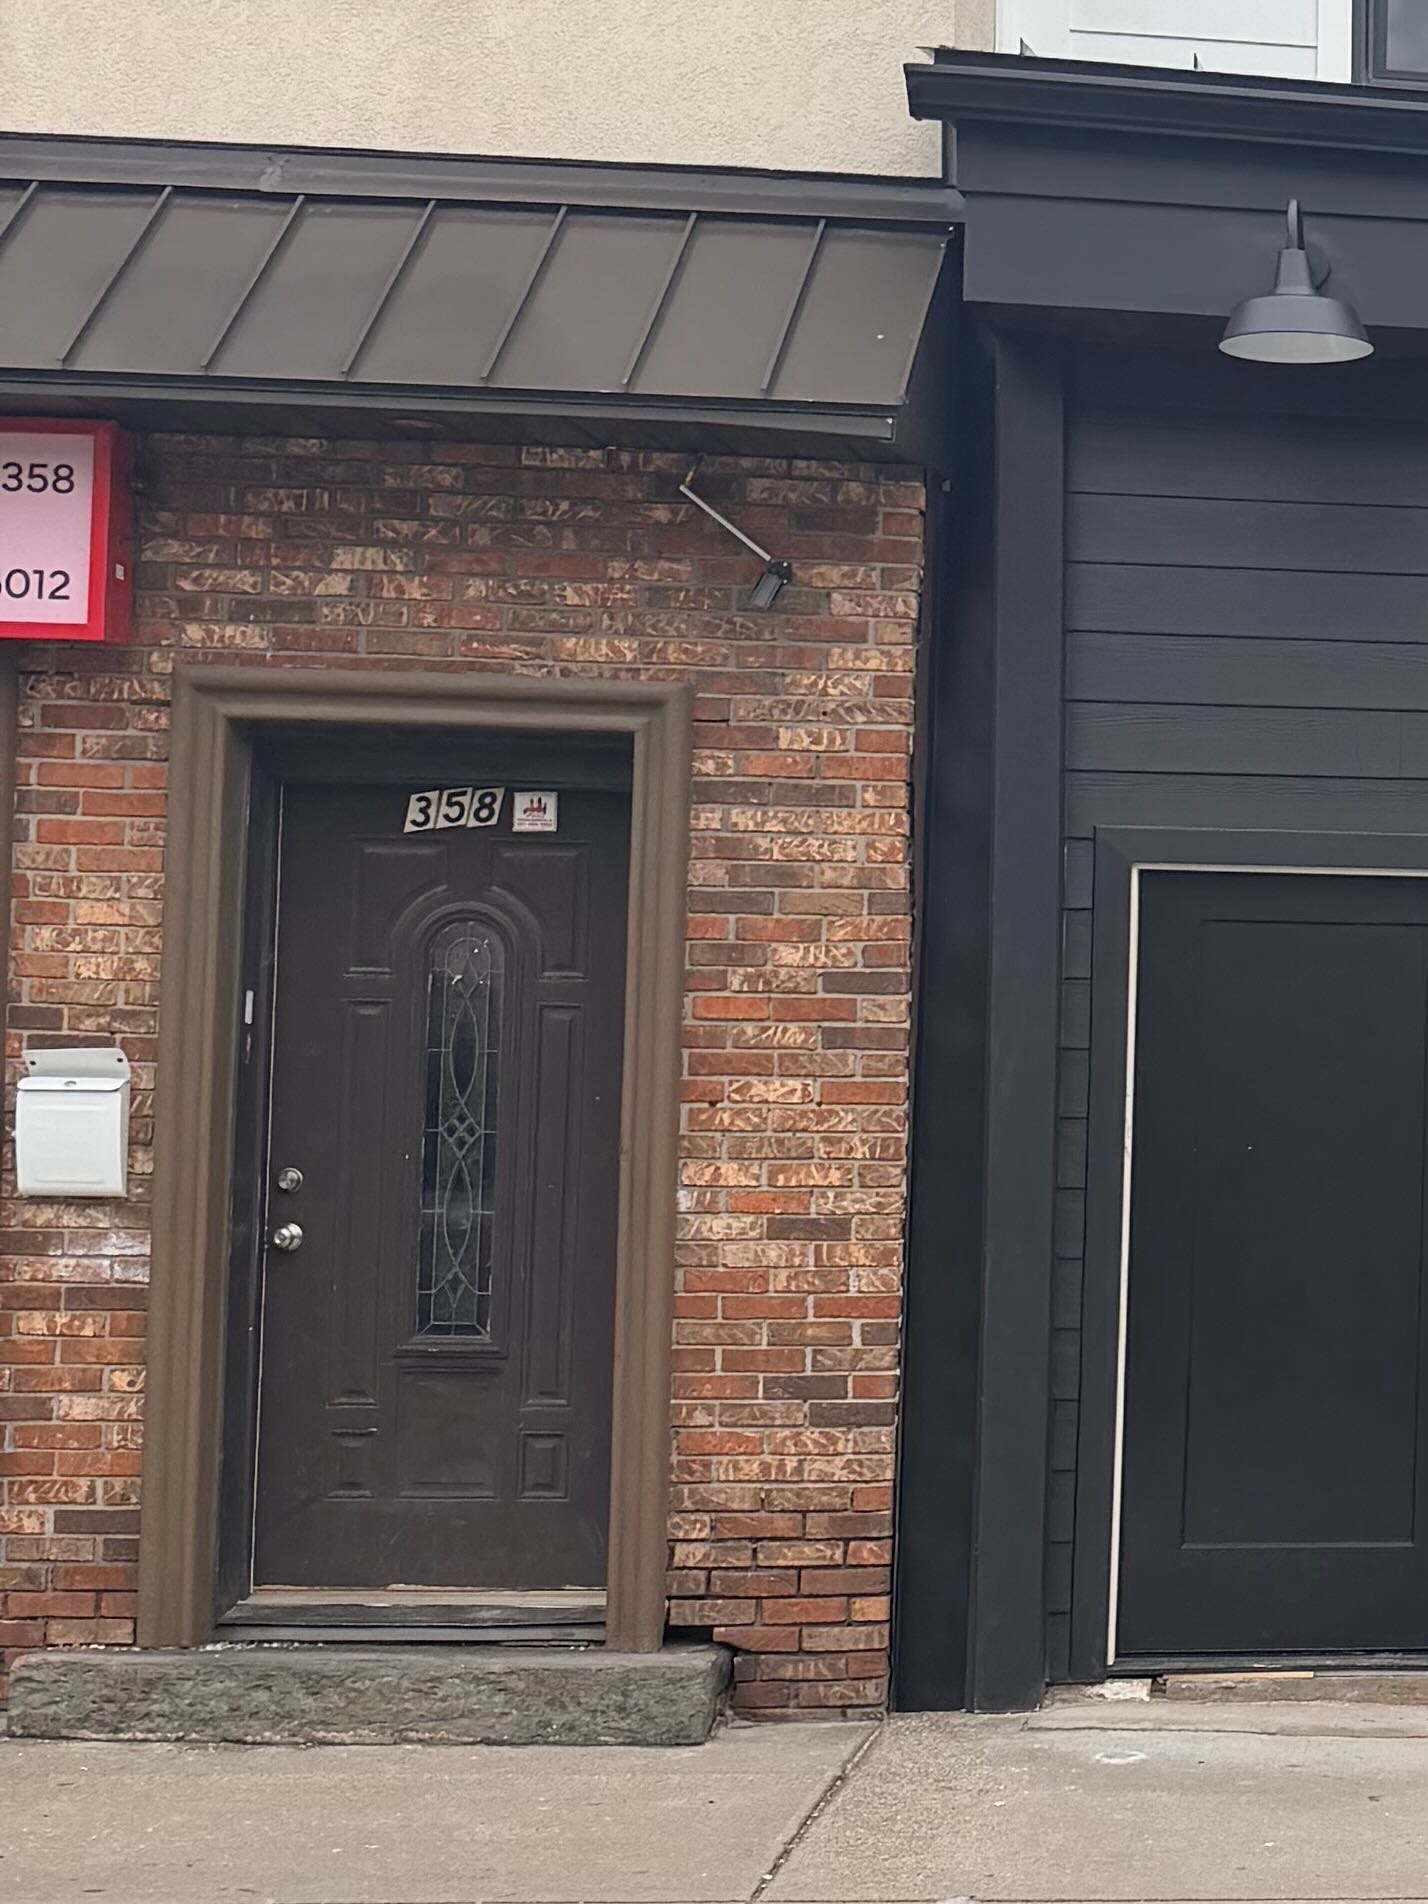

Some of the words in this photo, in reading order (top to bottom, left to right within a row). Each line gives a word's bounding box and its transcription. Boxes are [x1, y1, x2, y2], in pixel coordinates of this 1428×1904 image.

[1, 461, 75, 495] 358
[0, 568, 71, 600] 012
[410, 789, 498, 828] 358
